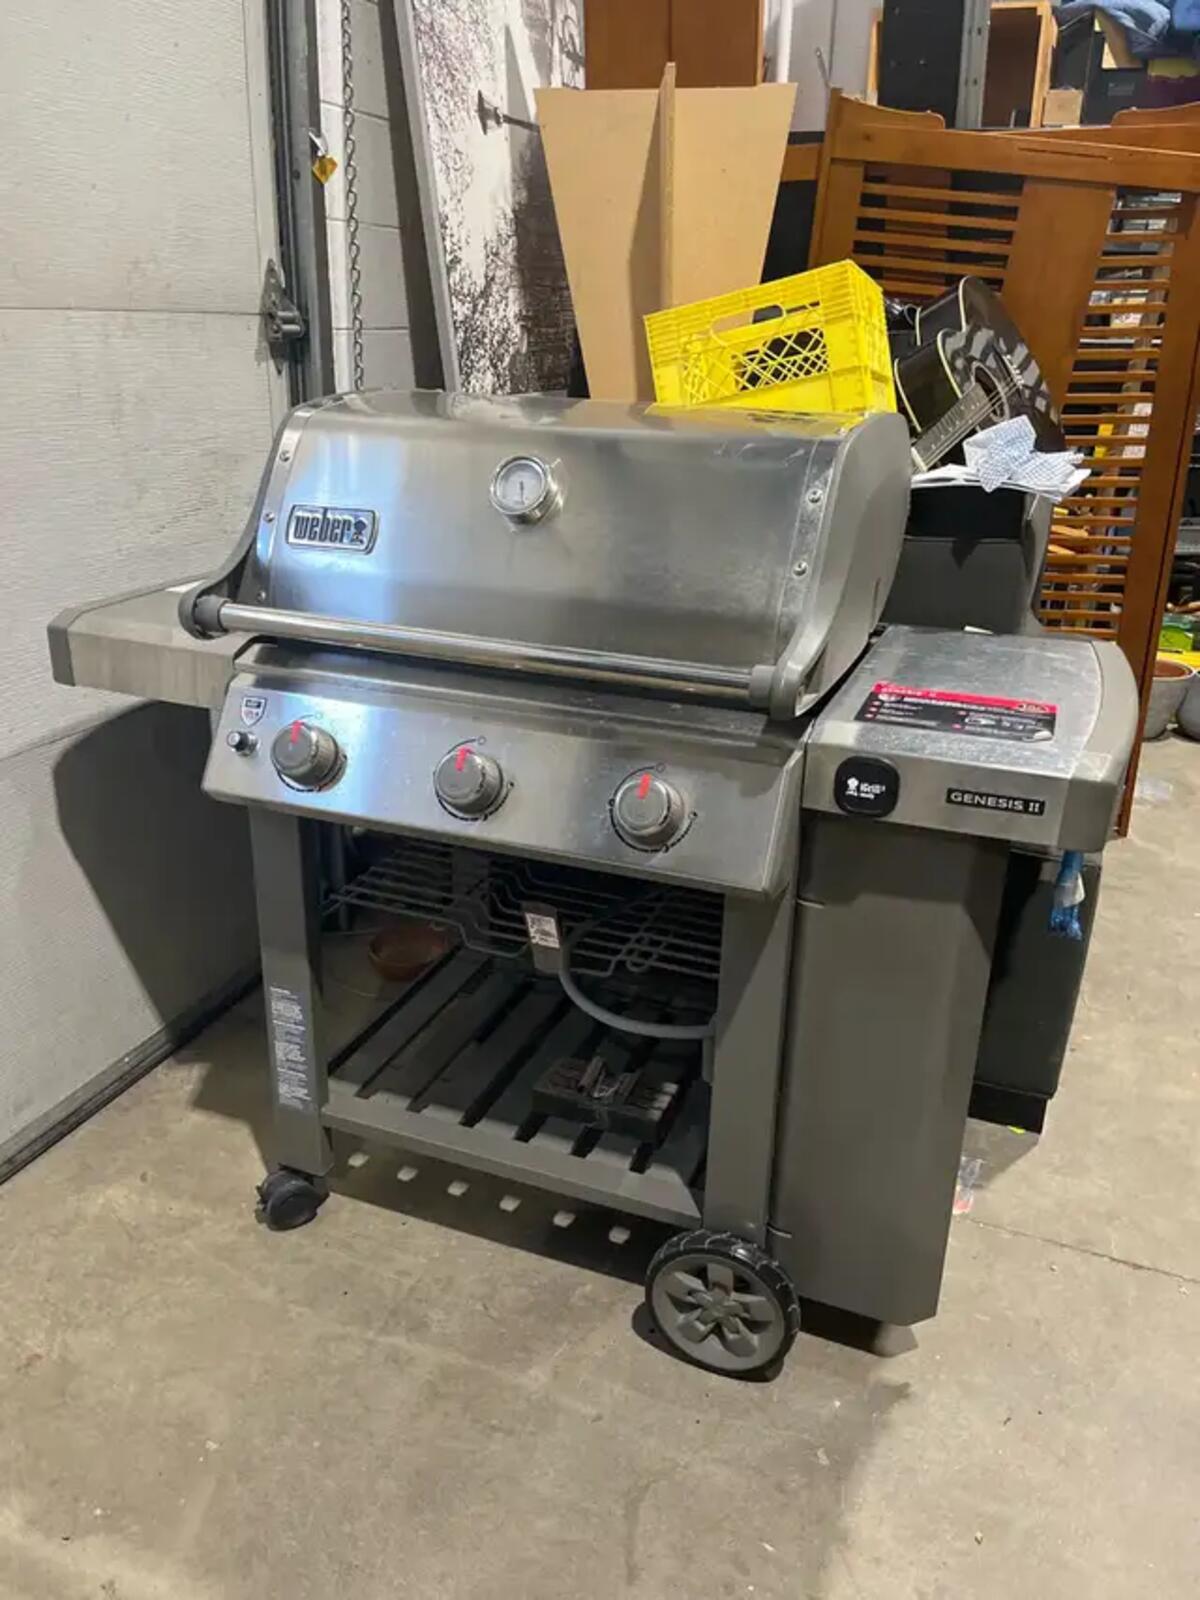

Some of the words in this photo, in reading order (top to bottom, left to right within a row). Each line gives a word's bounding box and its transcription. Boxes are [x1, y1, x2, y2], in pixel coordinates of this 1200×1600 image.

[293, 508, 352, 543] weber
[950, 791, 1024, 811] GENESIS
[1028, 802, 1040, 813] II
